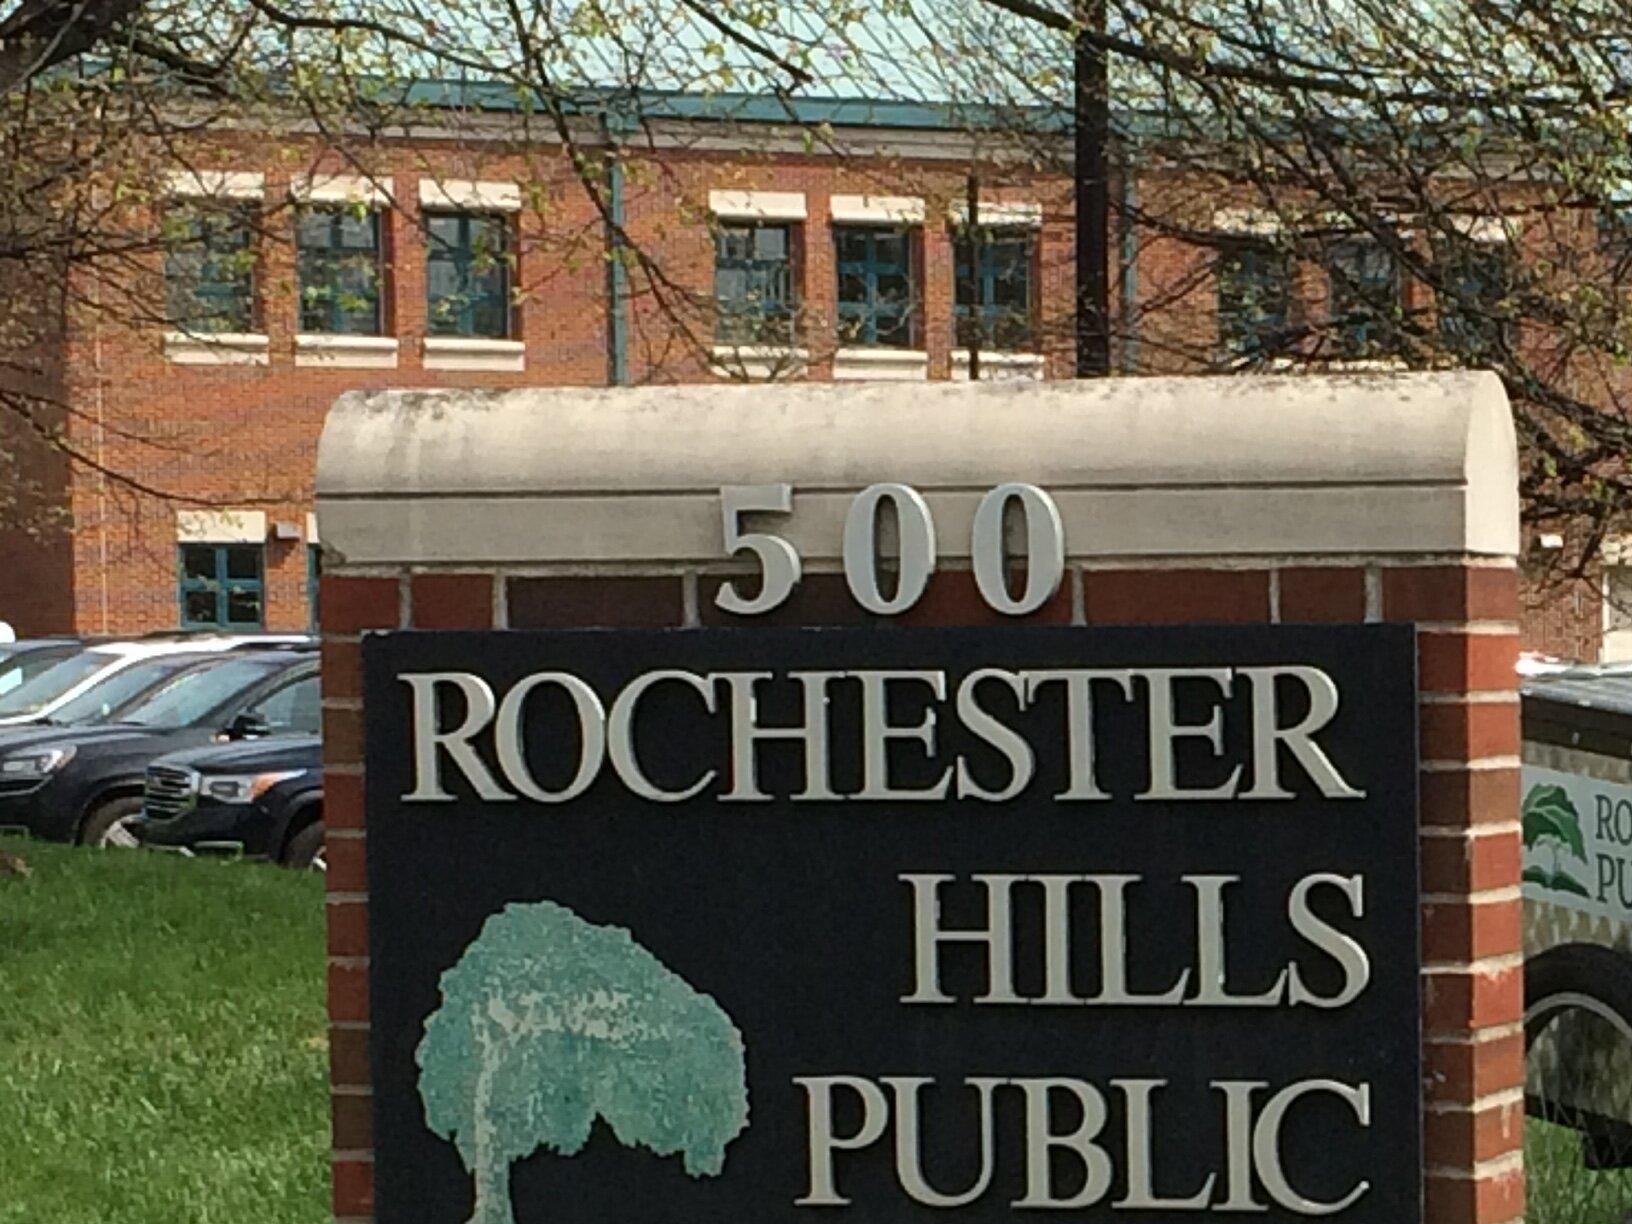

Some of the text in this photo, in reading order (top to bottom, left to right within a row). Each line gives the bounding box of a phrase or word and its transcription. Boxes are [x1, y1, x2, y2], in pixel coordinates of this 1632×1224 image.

[714, 482, 1067, 615] 500
[399, 665, 1367, 802] ROCHESTER
[899, 872, 1370, 1009] HILLS
[793, 1075, 1370, 1215] PUBLIC
